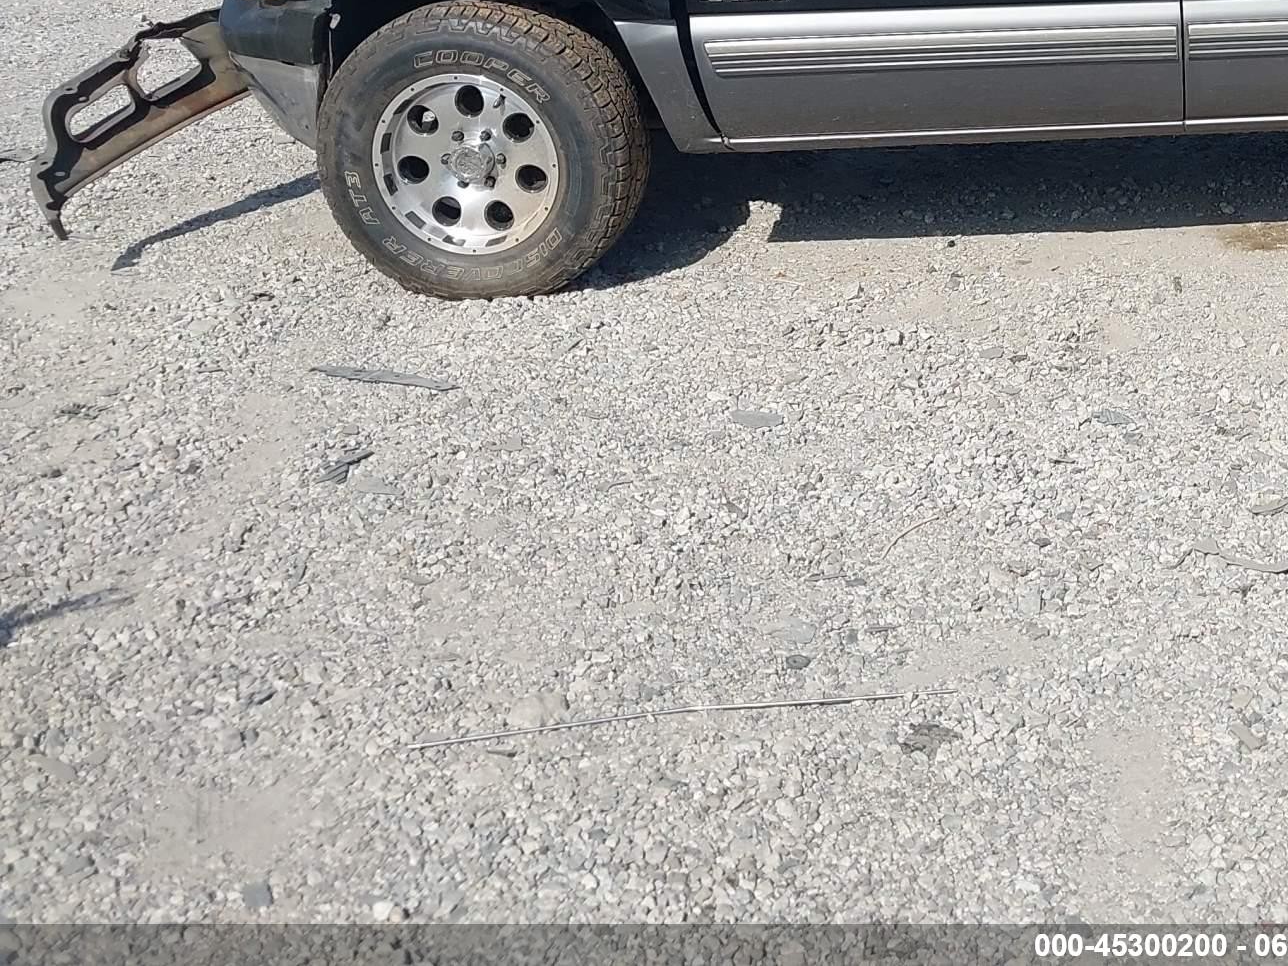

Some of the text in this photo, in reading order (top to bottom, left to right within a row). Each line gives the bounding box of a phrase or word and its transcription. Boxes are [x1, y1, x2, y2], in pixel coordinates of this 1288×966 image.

[413, 49, 550, 103] COOPER
[344, 170, 563, 281] DISCOVERER AT3
